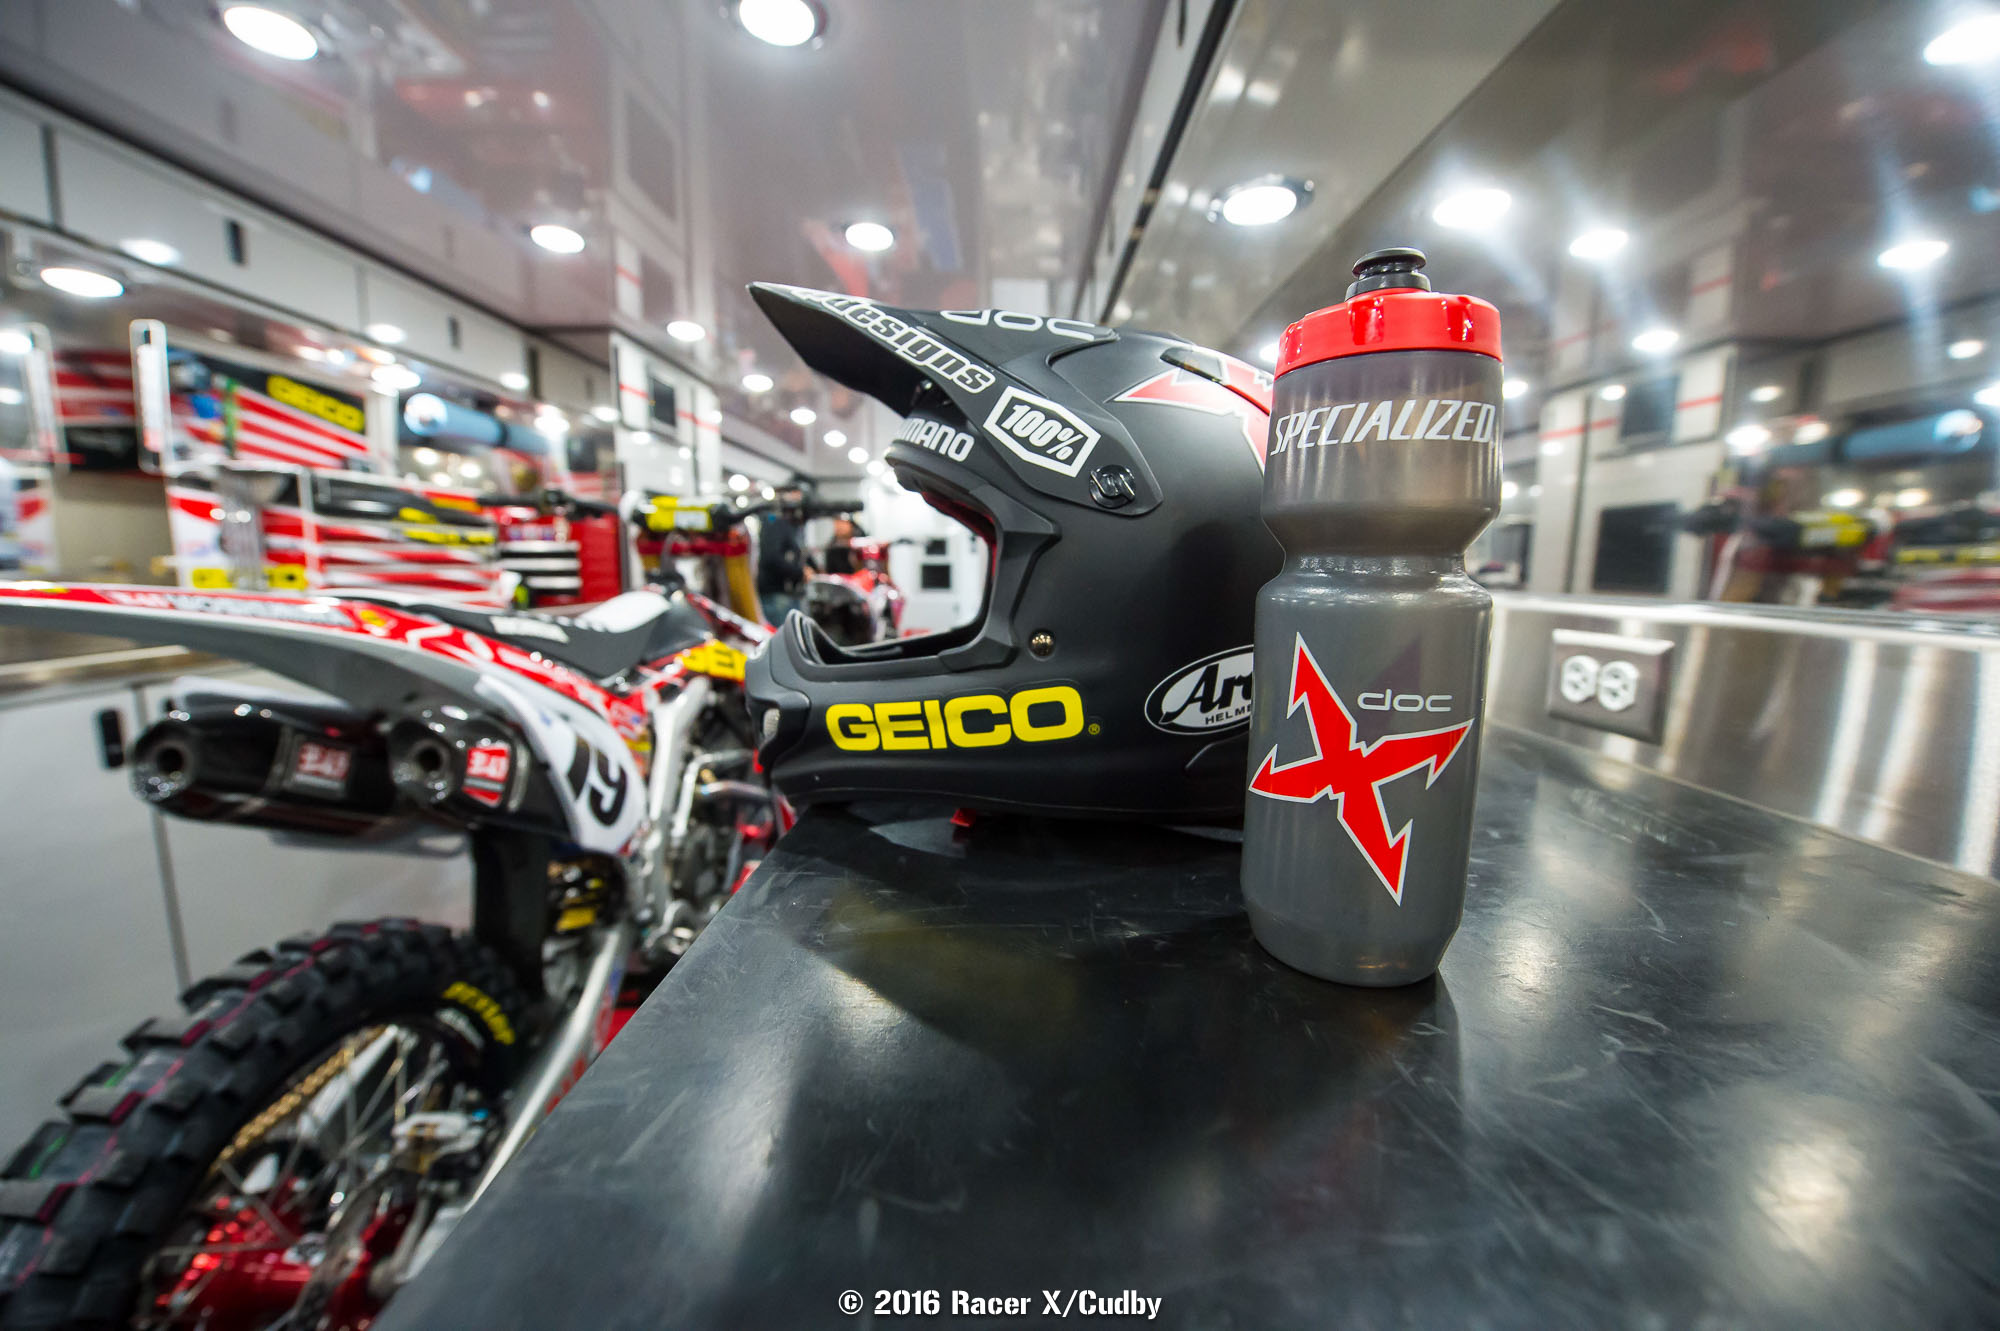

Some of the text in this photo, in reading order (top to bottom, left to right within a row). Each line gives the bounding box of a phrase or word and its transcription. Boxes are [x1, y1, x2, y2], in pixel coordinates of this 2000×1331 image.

[896, 417, 975, 462] IMANO
[1001, 404, 1083, 461] 100%
[1270, 399, 1497, 456] SPECIALIZED
[825, 685, 1085, 751] GEICO
[1159, 663, 1253, 724] Ar
[1205, 703, 1252, 725] HELM
[1357, 688, 1453, 712] doc
